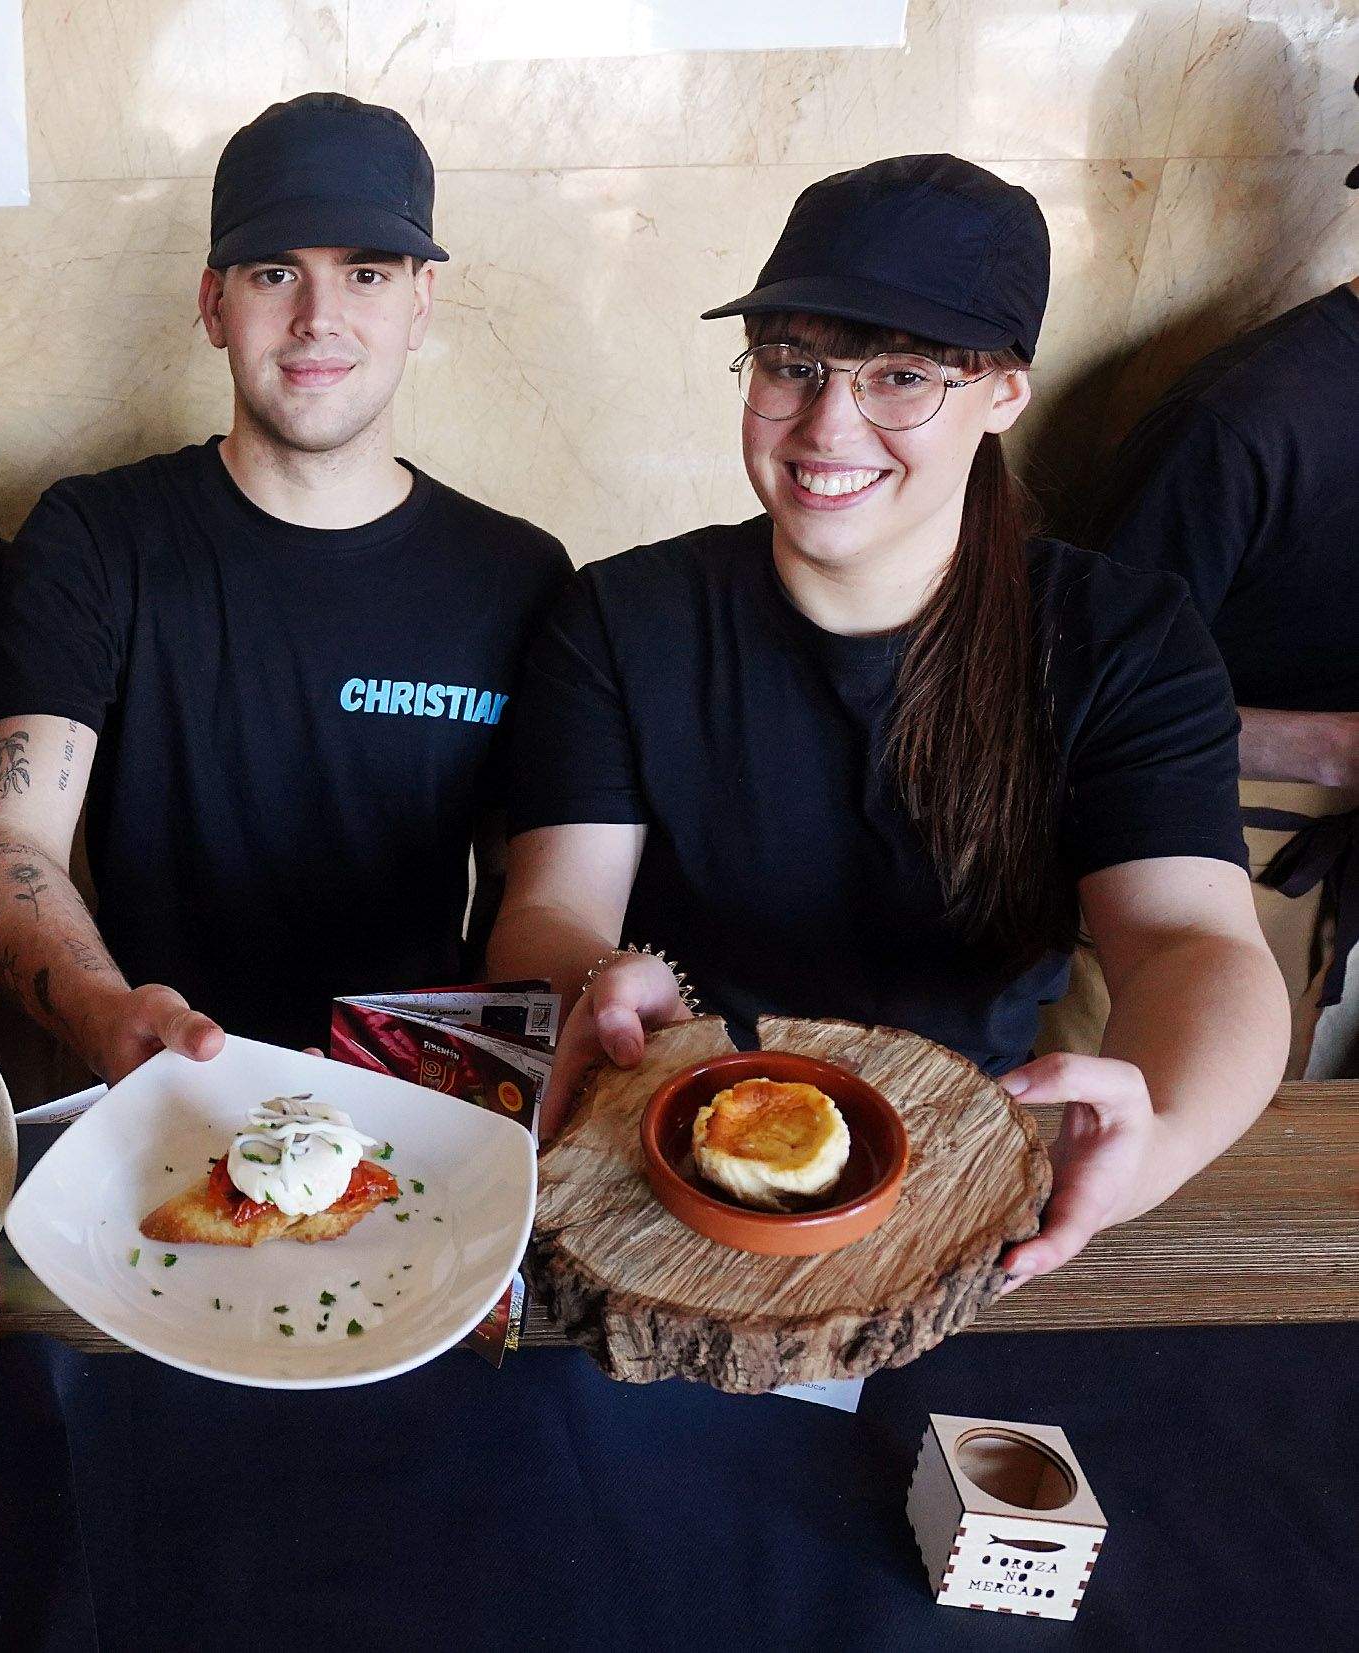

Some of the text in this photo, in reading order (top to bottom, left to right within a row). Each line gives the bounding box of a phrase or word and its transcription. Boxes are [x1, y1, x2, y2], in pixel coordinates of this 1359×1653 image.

[982, 1555, 1058, 1573] O OROZA
[1004, 1571, 1027, 1582] NO
[968, 1579, 1055, 1598] MERCADO
